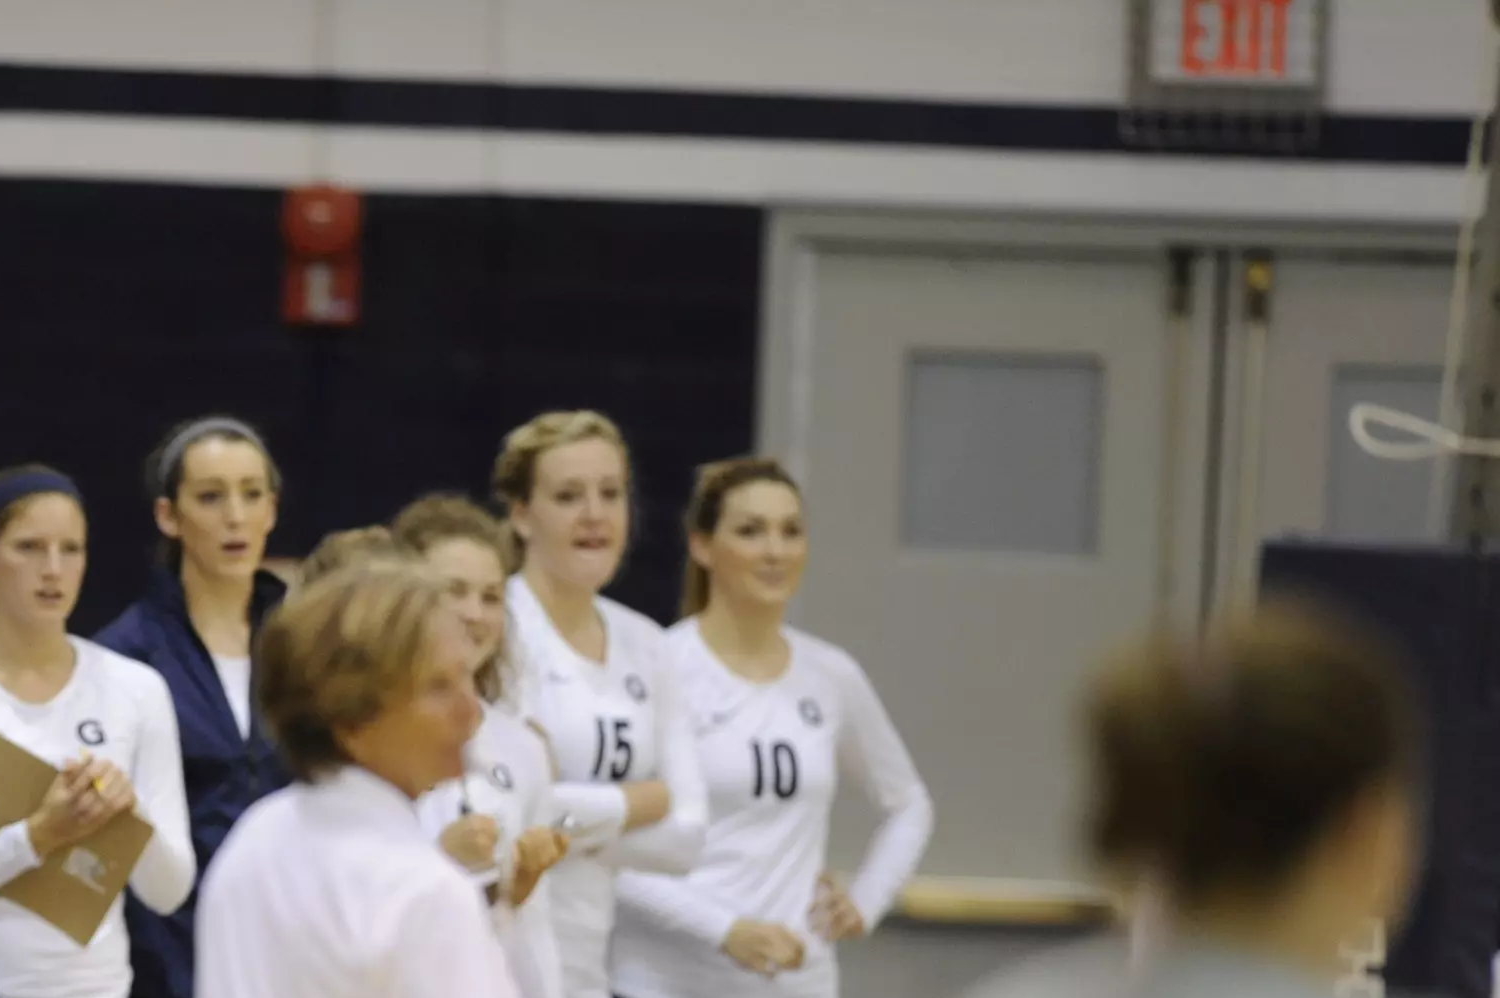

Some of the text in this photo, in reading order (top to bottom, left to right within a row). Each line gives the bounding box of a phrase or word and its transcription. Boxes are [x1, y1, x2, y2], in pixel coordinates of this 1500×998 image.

[1180, 0, 1289, 76] EXIT
[77, 718, 105, 746] G
[592, 716, 632, 780] 15
[750, 740, 798, 800] 10
